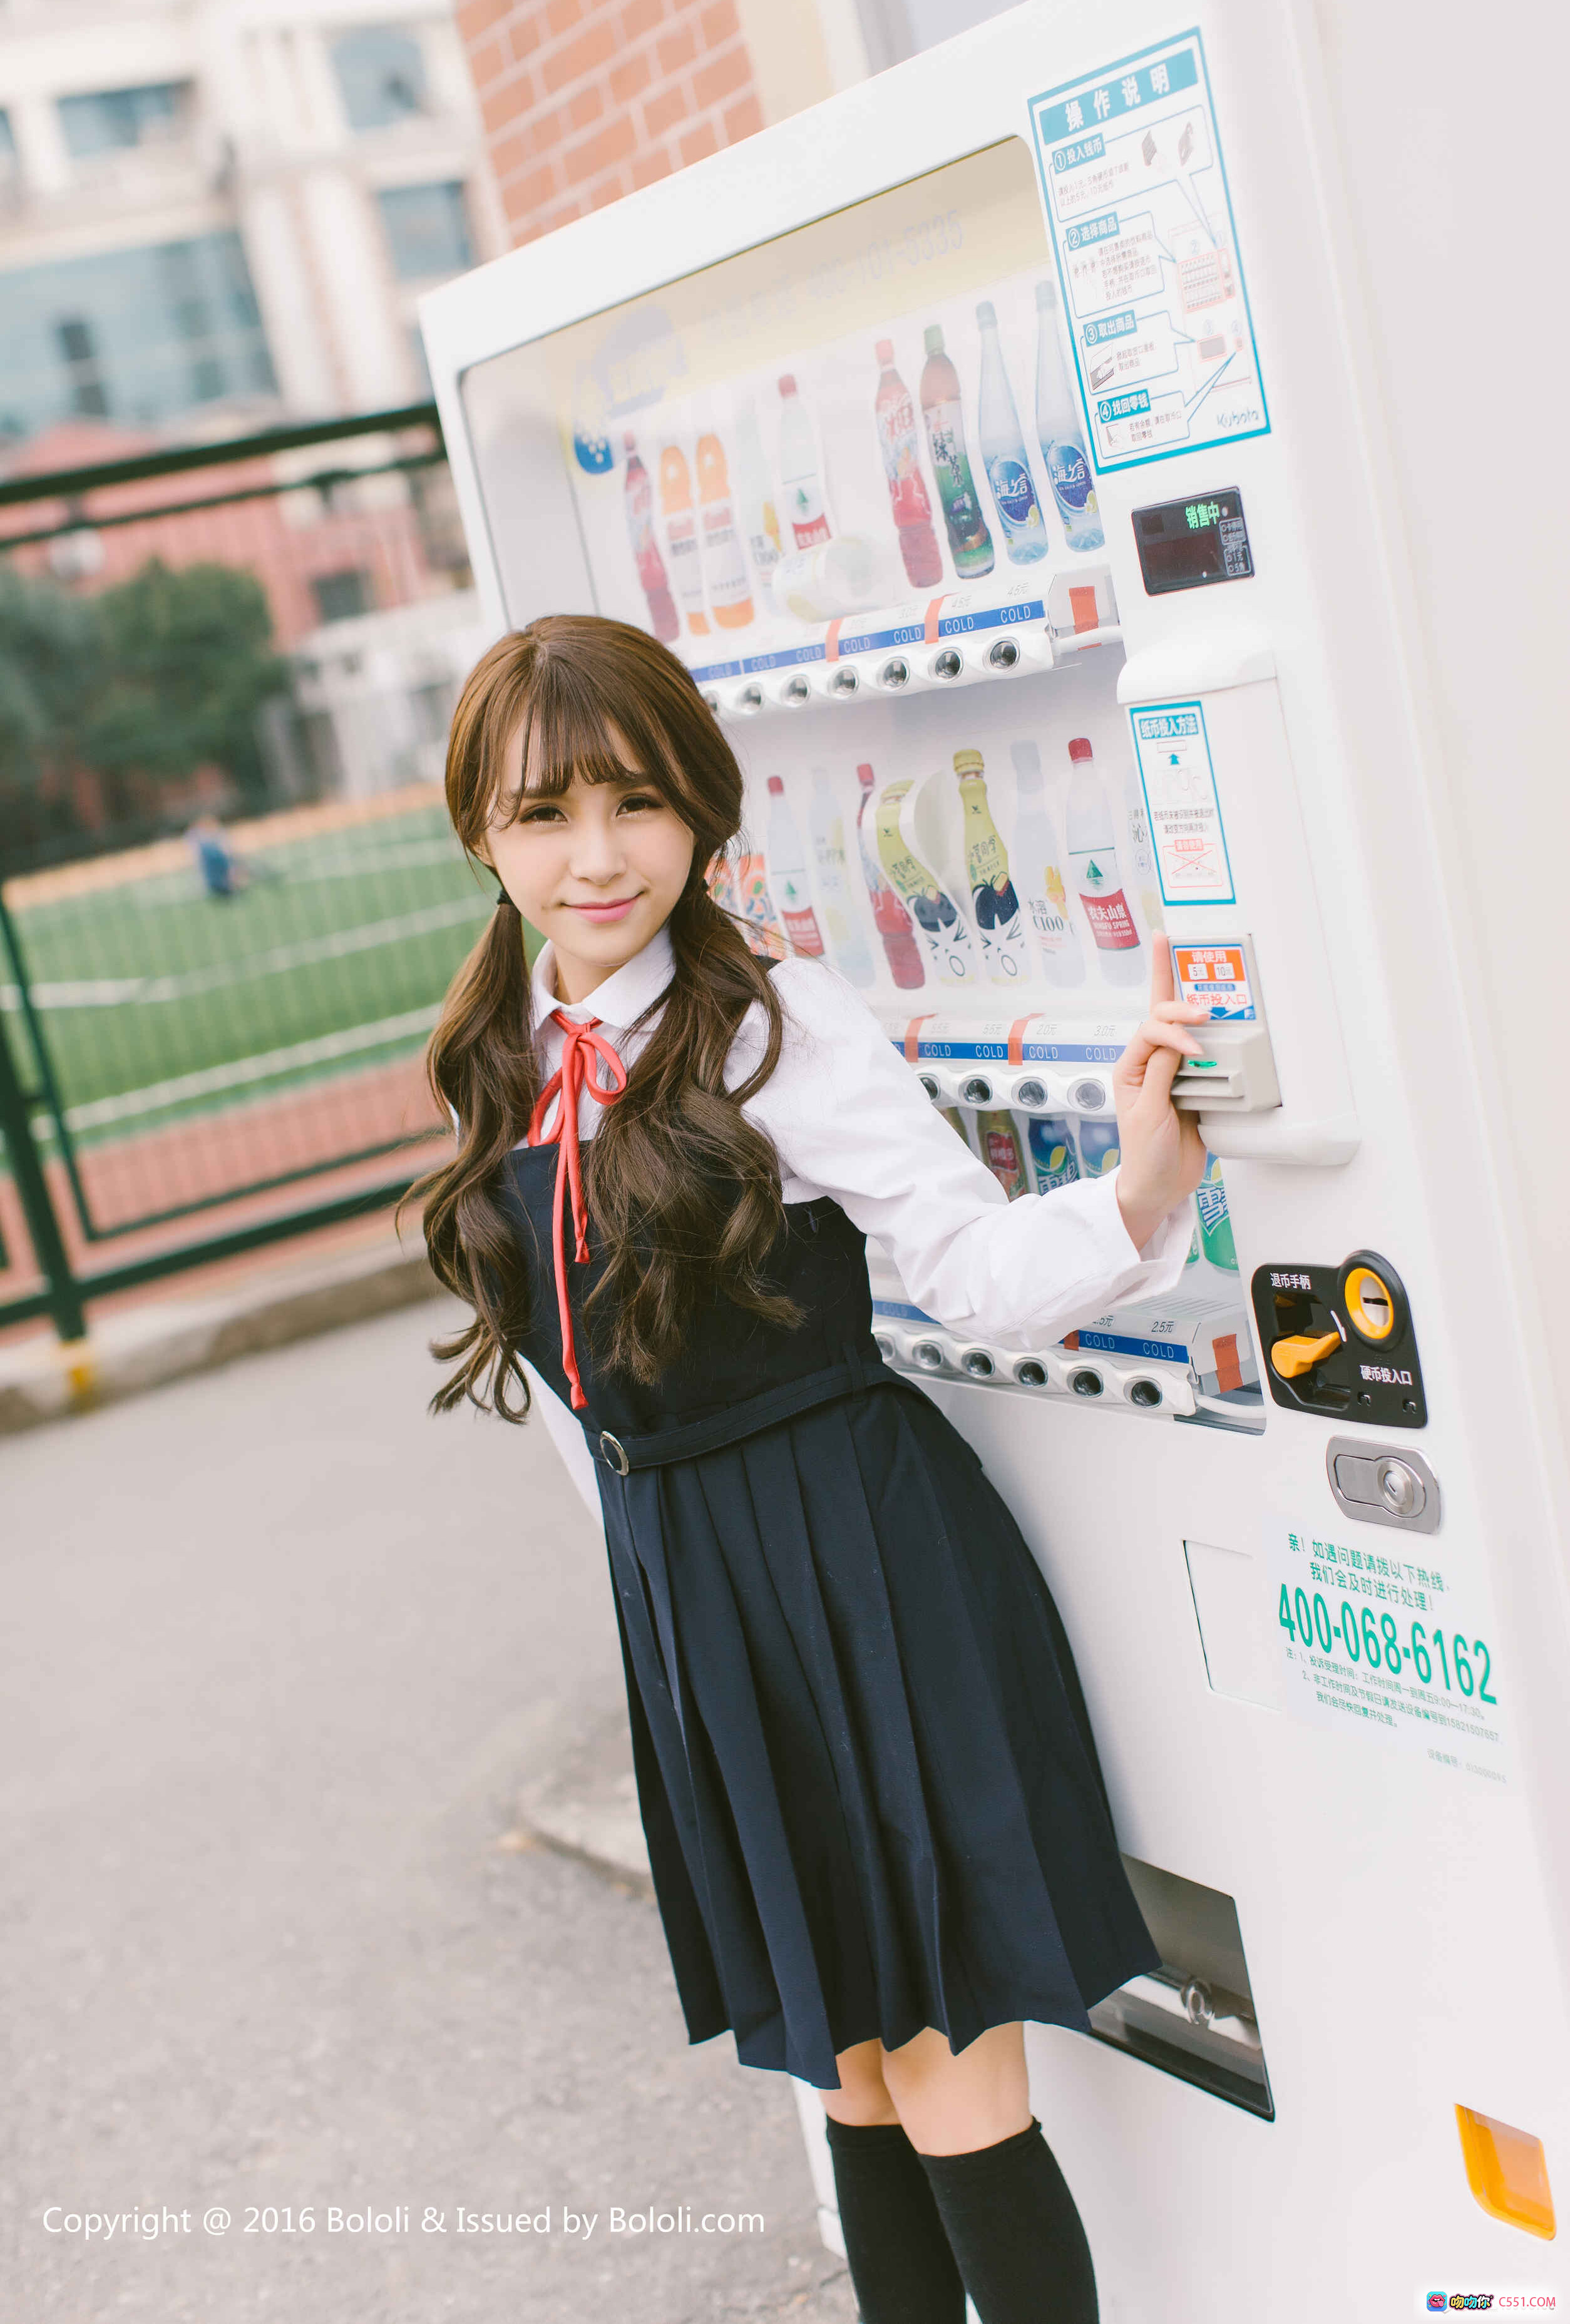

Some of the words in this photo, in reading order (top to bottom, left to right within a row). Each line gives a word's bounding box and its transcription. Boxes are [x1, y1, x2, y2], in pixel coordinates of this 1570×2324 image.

[1065, 63, 1170, 131] 操作说明
[1185, 501, 1220, 530] 销售中
[751, 654, 777, 673] COLD
[795, 645, 822, 663] COLD
[843, 637, 871, 654] COLD
[893, 626, 922, 645] COLD
[945, 617, 974, 635] COLD
[1000, 605, 1031, 624] COLD
[1087, 903, 1127, 921] 农夫山泉
[1191, 950, 1228, 964] 请使用
[1186, 993, 1248, 1006] 纸币投入口
[923, 1043, 952, 1058] COLD
[975, 1044, 1004, 1058] COLD
[1029, 1045, 1059, 1060] COLD
[1085, 1046, 1117, 1061] COLD
[1270, 1272, 1311, 1291] 退币手柄
[1151, 1319, 1174, 1334] 2.5元
[1084, 1333, 1116, 1351] COLD
[1142, 1343, 1176, 1359] COLD
[1358, 1364, 1413, 1386] 硬币投入口
[1309, 1561, 1434, 1611] 我们会及时进行处理！
[1278, 1582, 1498, 1706] 400-068-6162
